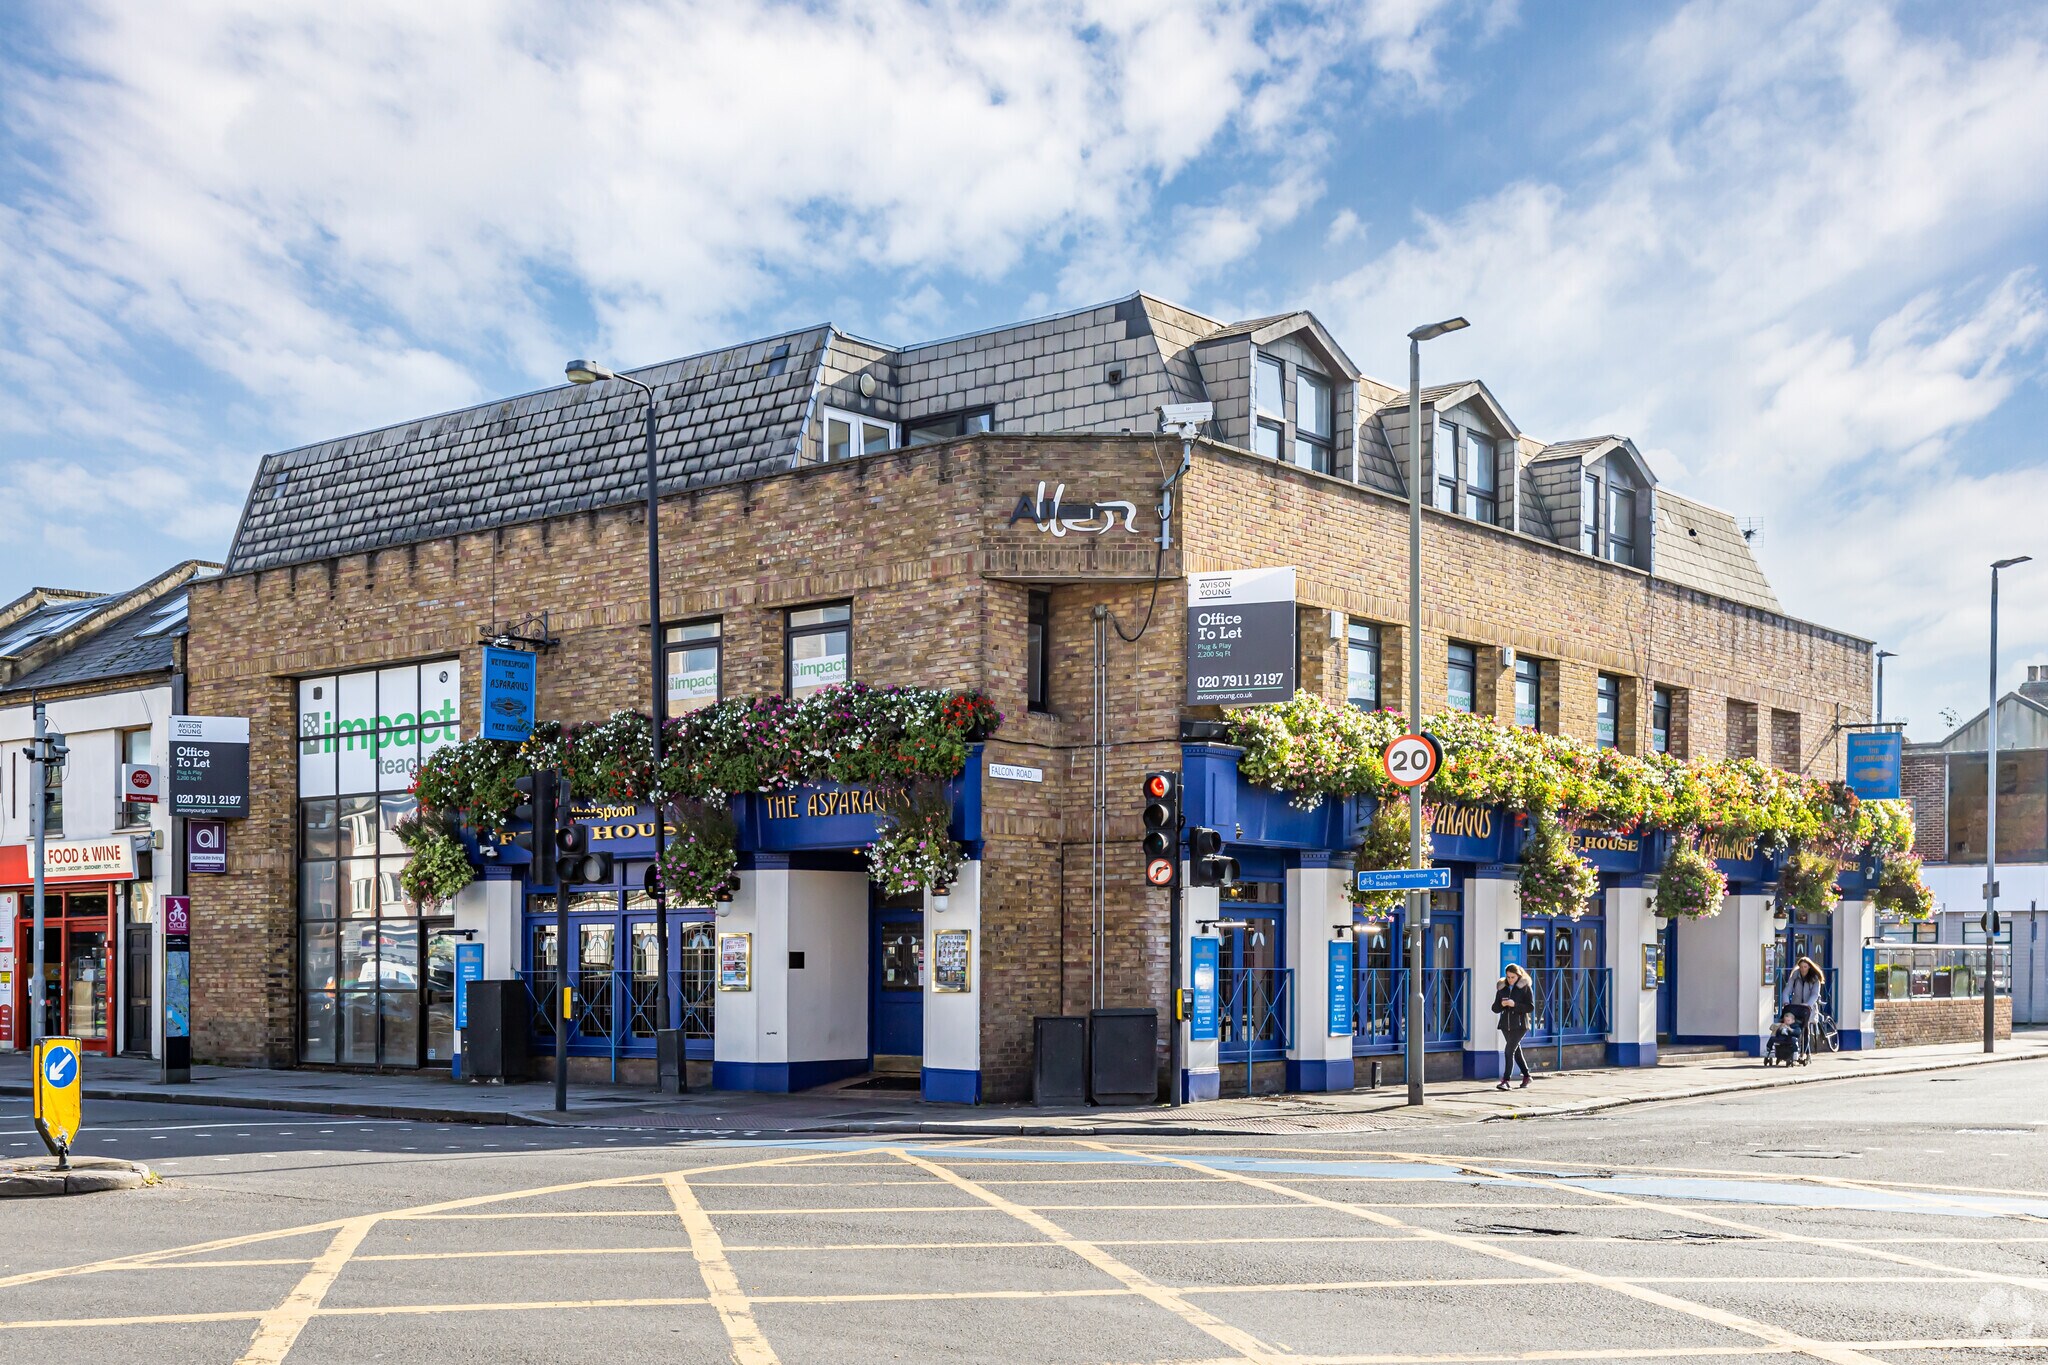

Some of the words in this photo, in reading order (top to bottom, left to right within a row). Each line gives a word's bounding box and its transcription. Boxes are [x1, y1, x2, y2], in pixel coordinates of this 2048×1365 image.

[1199, 581, 1231, 589] AVISON
[1200, 588, 1231, 597] YOUNG
[1197, 612, 1242, 626] Office
[1197, 627, 1216, 640] To
[1219, 626, 1243, 639] Let
[1197, 643, 1211, 651] Plug
[1218, 642, 1232, 651] Play
[1215, 650, 1224, 658] Sq
[799, 658, 847, 677] impact
[674, 673, 718, 691] impact
[1197, 676, 1220, 688] 020
[1221, 674, 1250, 687] 7911
[1253, 673, 1284, 686] 2197
[1348, 677, 1376, 691] mpact
[1197, 691, 1253, 701] avisonyoung.co.uk
[1448, 694, 1471, 707] mpact
[324, 699, 455, 760] impact
[176, 746, 210, 757] Office
[176, 757, 191, 768] To
[193, 757, 211, 768] Let
[379, 756, 427, 775] teac
[1392, 749, 1428, 771] 20
[192, 769, 203, 777] Play
[991, 765, 1014, 777] FALCON
[1016, 768, 1033, 779] ROAD
[176, 794, 194, 804] 020
[195, 795, 217, 804] 7911
[218, 795, 241, 805] 2197
[766, 795, 799, 819] THE
[1585, 836, 1639, 852] HOUSE
[48, 848, 79, 865] FOOD
[82, 847, 89, 862] &
[91, 845, 121, 862] WINE
[1375, 873, 1402, 881] Clapham
